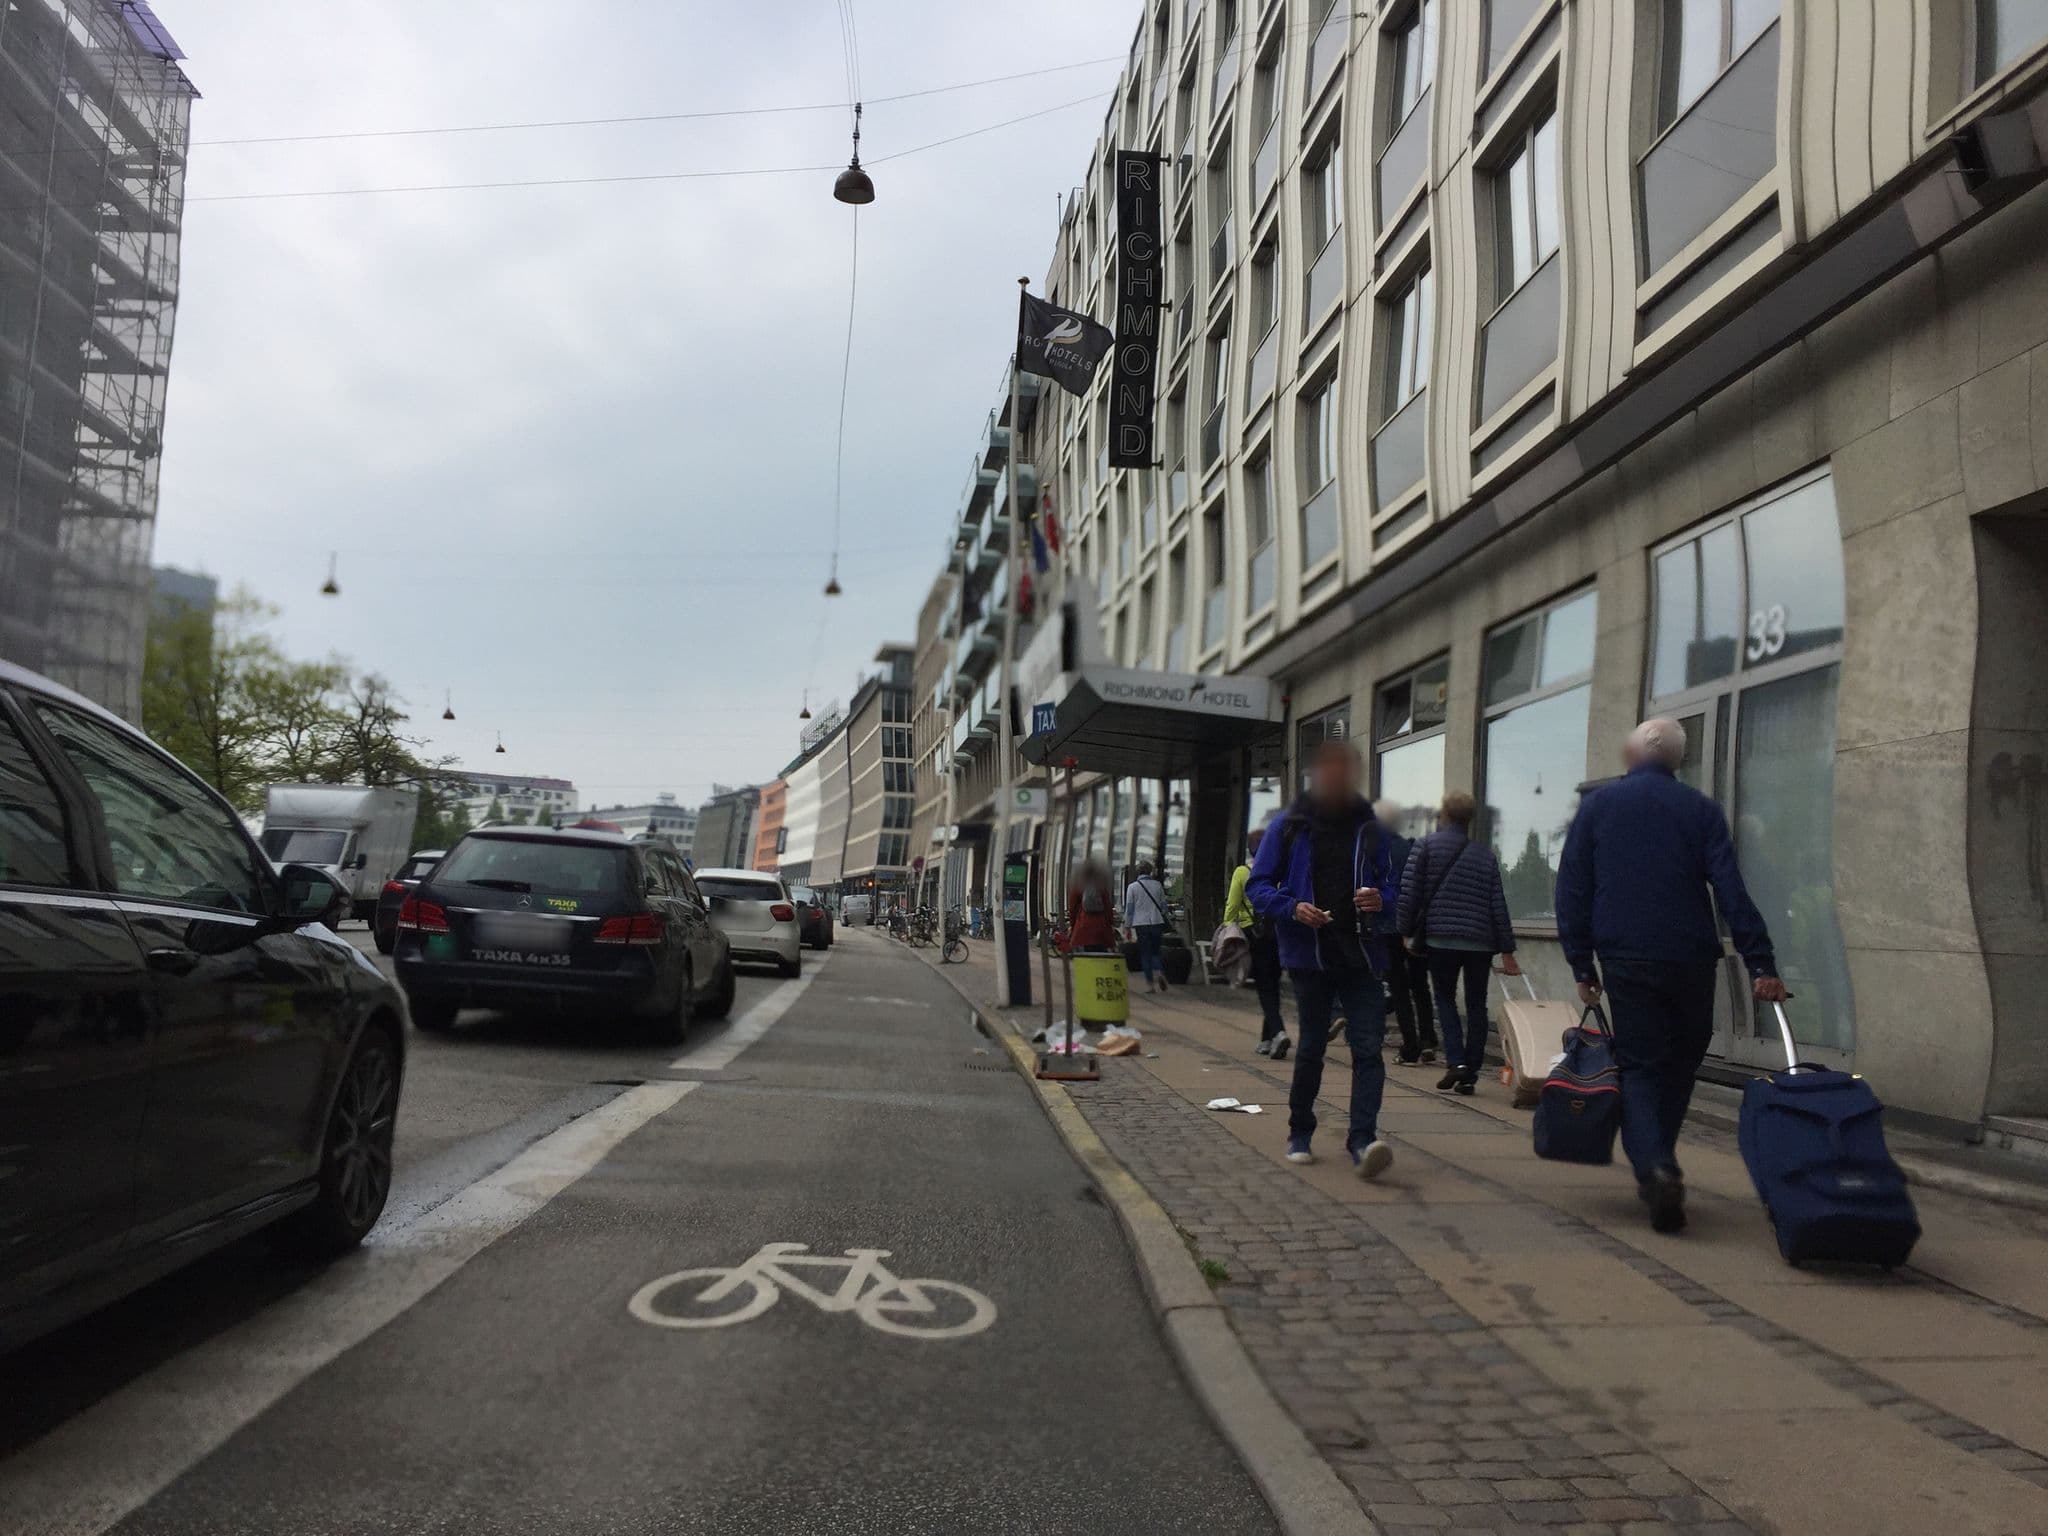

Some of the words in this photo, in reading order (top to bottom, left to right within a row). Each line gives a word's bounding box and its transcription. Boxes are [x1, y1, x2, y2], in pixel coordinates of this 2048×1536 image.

[1119, 159, 1154, 457] RICHMOND
[1050, 346, 1093, 371] HOTELS
[1746, 604, 1786, 662] 33
[1103, 680, 1186, 703] RICHMOND
[1201, 687, 1252, 709] HOTEL
[547, 898, 577, 908] TAXA
[472, 949, 522, 963] TAXA
[1096, 977, 1123, 988] REN
